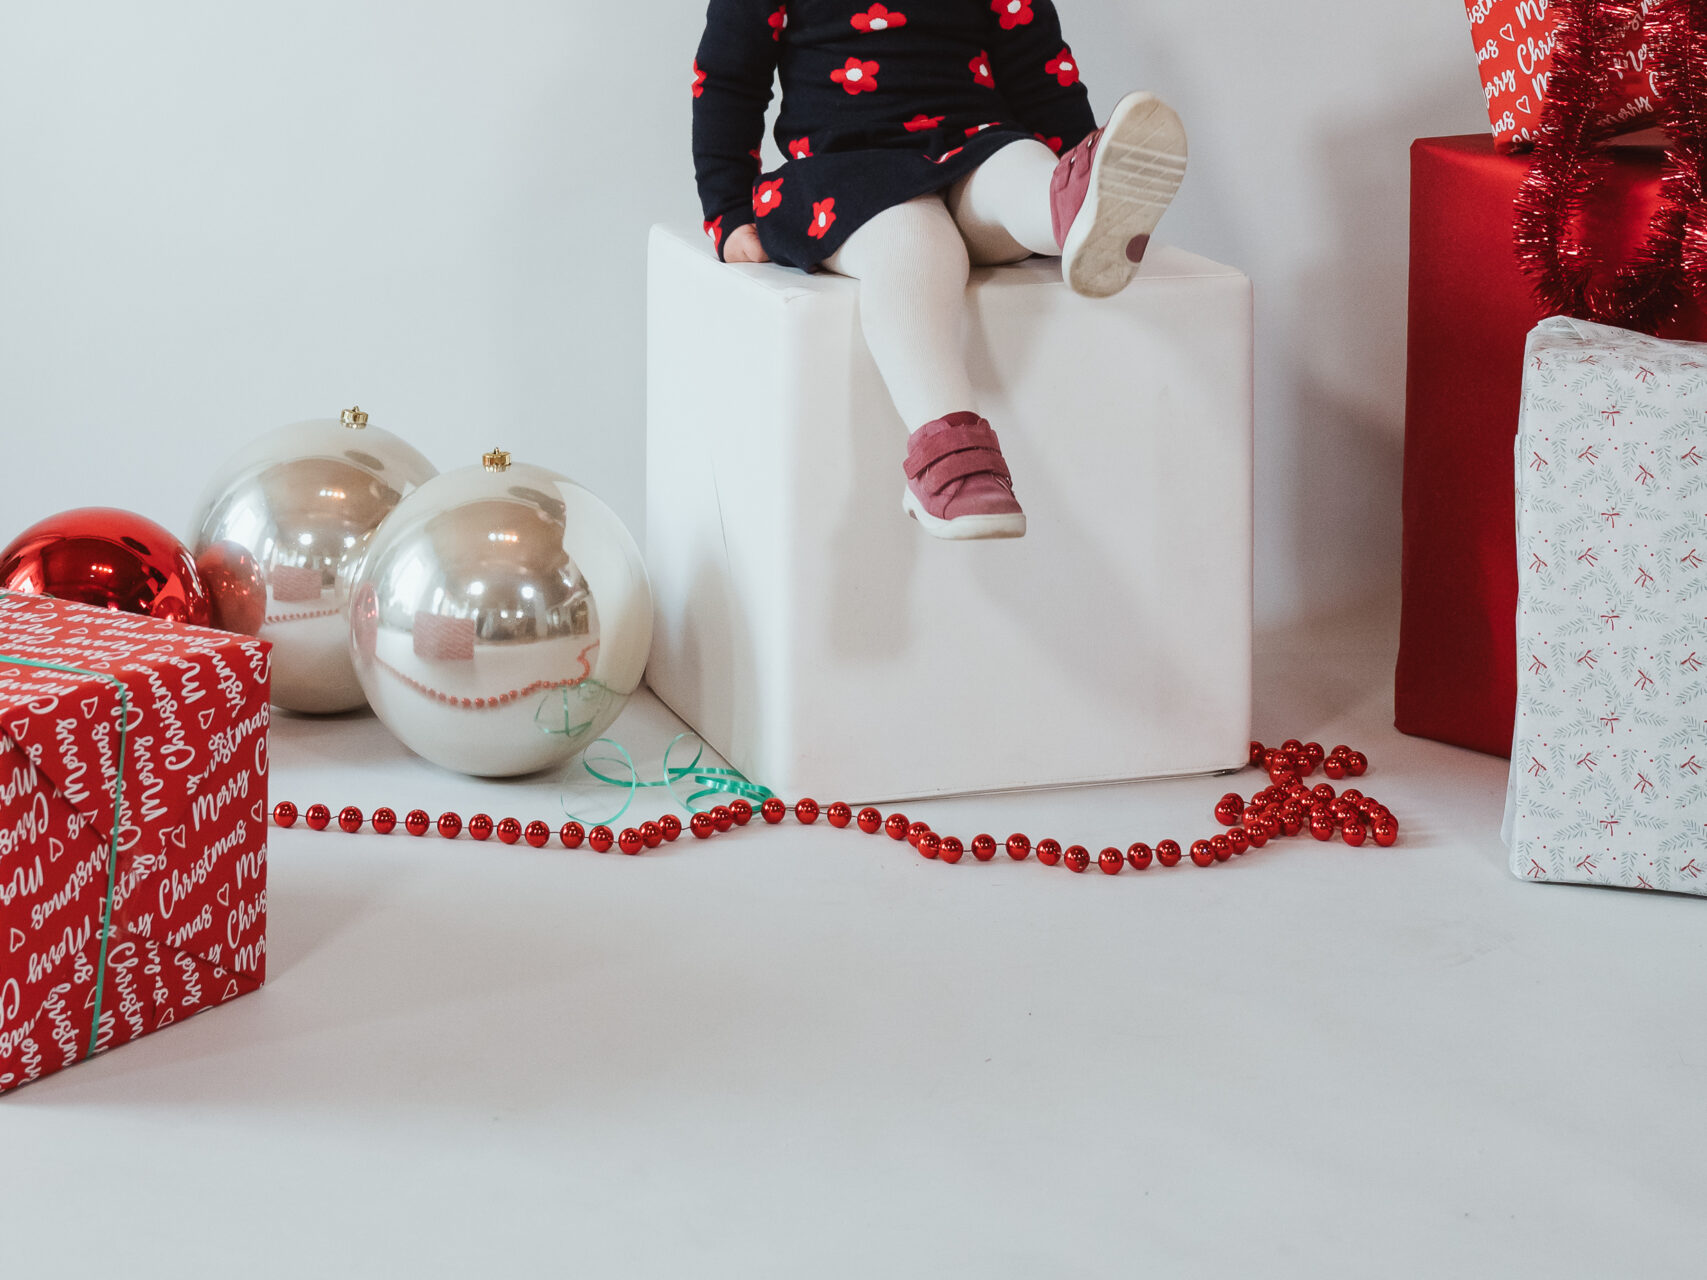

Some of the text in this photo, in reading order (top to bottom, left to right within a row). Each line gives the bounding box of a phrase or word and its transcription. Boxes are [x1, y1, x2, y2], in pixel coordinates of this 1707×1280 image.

[121, 663, 195, 771] Christmas
[55, 718, 91, 804] Merry
[133, 735, 169, 822] Merry
[192, 769, 250, 832] Merry
[159, 819, 247, 920] Christmas
[27, 915, 91, 985] Merry
